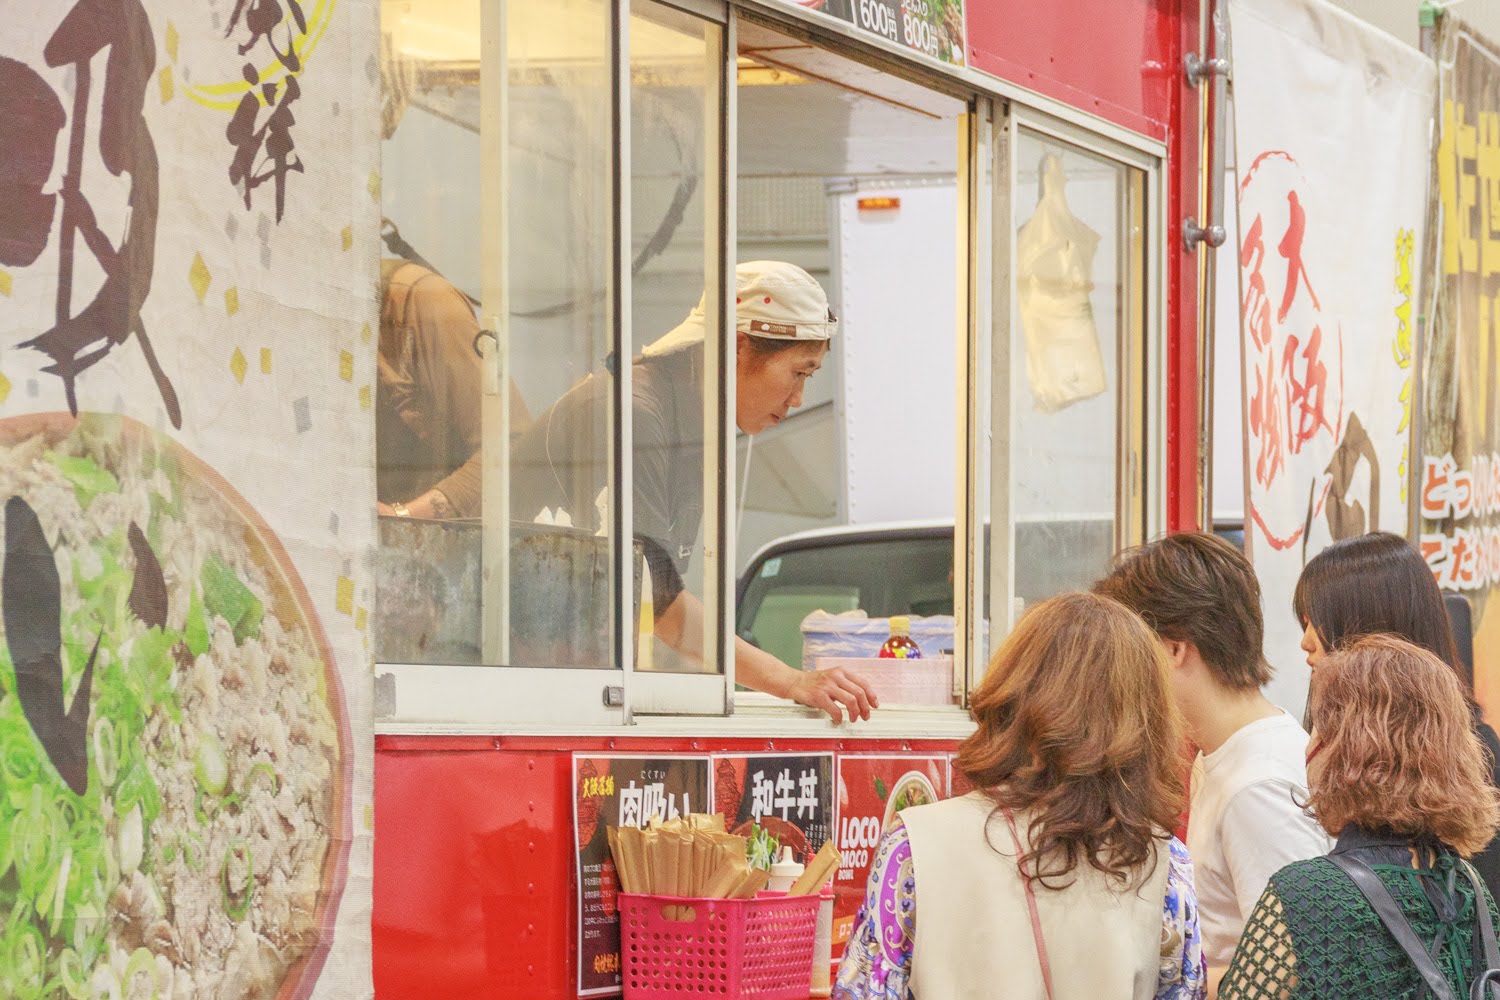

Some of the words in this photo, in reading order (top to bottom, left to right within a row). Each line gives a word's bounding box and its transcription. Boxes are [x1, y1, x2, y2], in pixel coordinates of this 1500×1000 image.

[1278, 190, 1335, 456] 大阪
[751, 768, 819, 823] 和牛丼
[841, 816, 880, 849] LOCO
[838, 869, 854, 880] BOWL
[839, 850, 868, 869] MOCO
